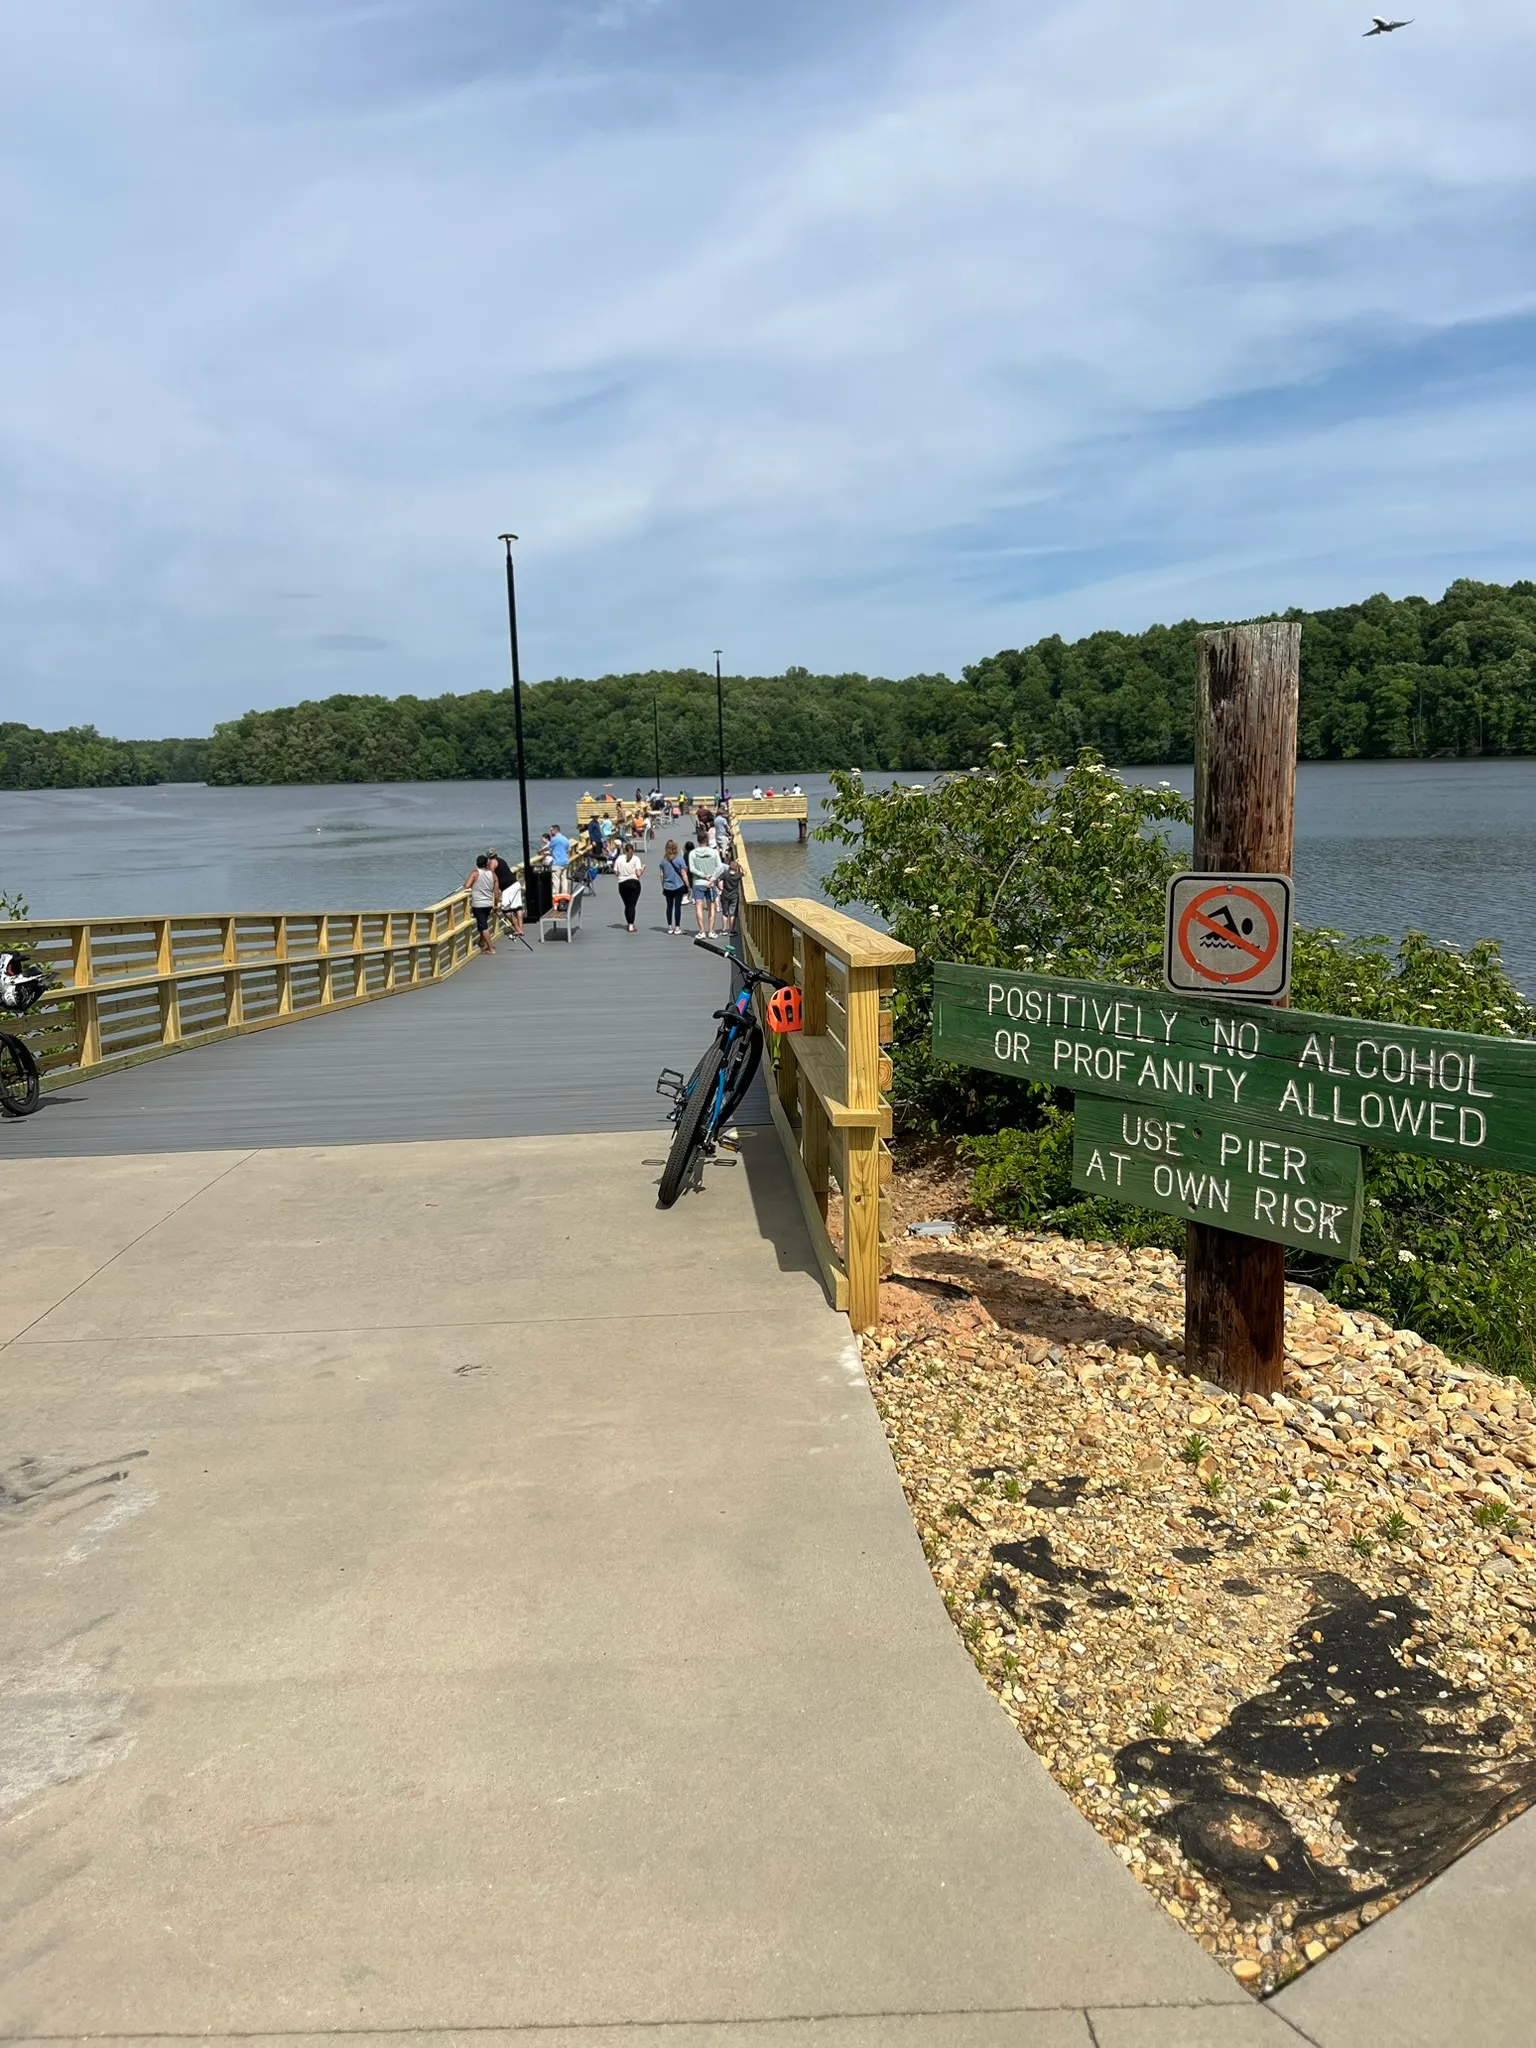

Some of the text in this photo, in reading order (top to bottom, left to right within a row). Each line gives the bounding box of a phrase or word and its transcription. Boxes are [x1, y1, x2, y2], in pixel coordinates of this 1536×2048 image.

[988, 982, 1494, 1098] POSITIVELY NO ALCOHOL
[993, 1029, 1031, 1064] OR
[1278, 1079, 1487, 1148] ALLOWED
[1085, 1149, 1348, 1244] AT OWN RISK
[1121, 1113, 1307, 1185] USE PIER
